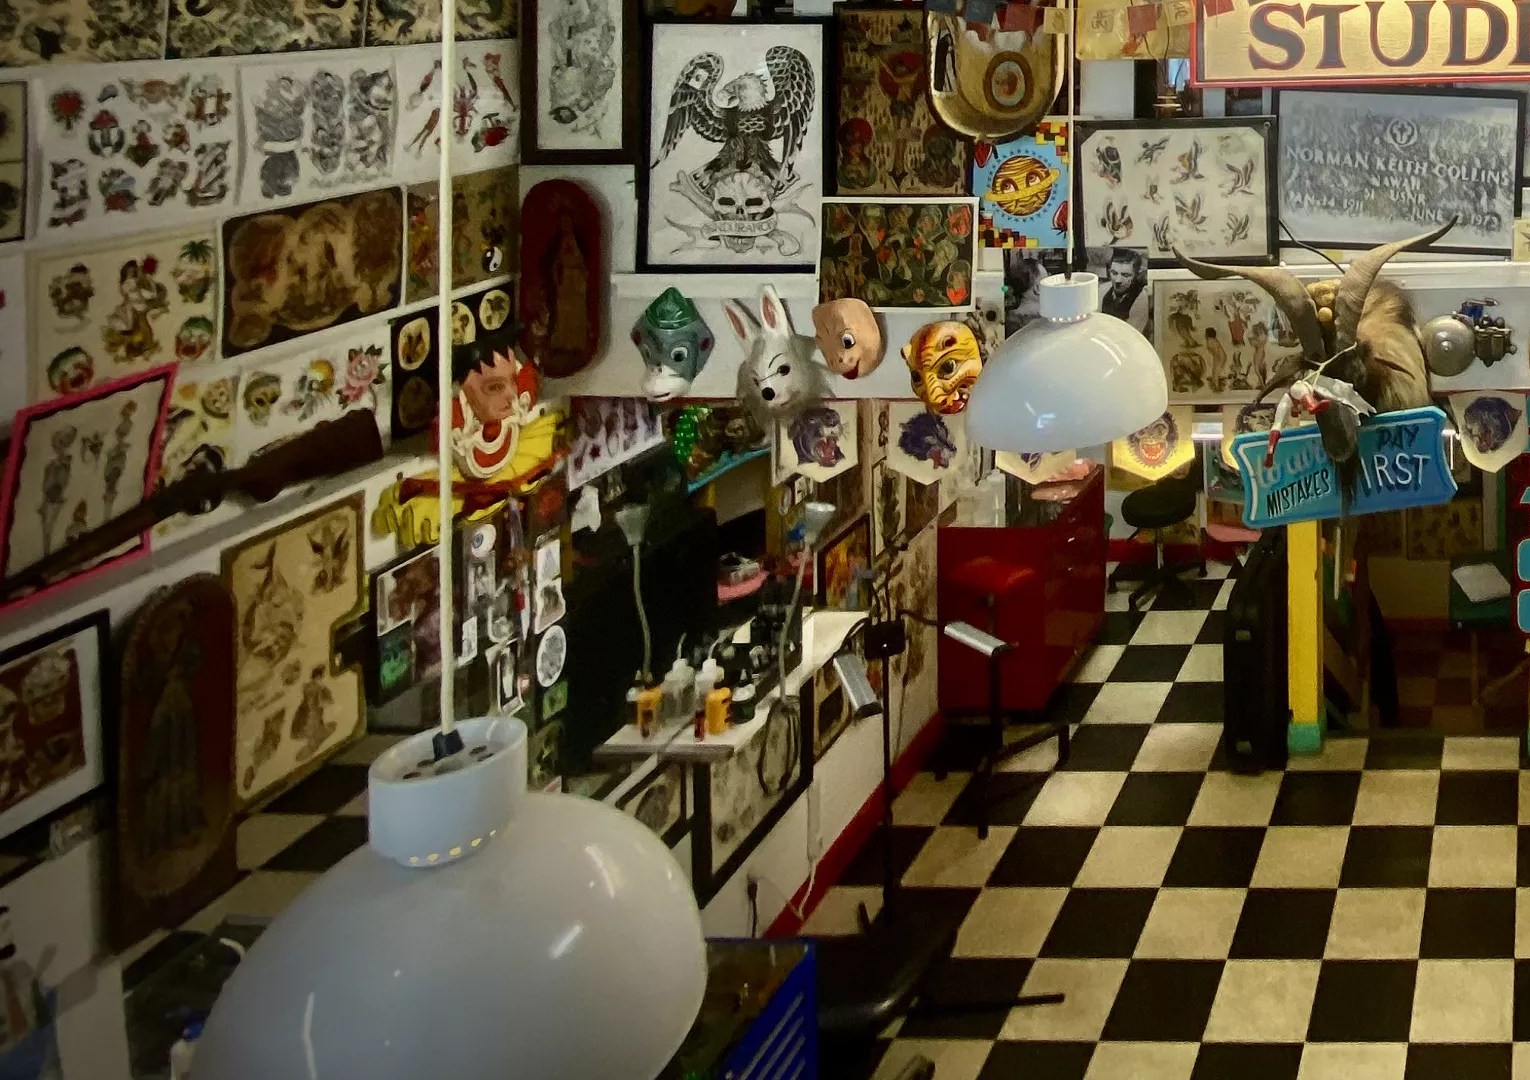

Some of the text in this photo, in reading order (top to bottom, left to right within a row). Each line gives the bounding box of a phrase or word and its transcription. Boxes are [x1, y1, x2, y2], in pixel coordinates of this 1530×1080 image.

[1286, 145, 1509, 186] NORMAN KEITH COLLINS
[1375, 423, 1420, 452] PAY
[1266, 467, 1331, 518] MISTAKES
[1358, 453, 1433, 492] IRST
